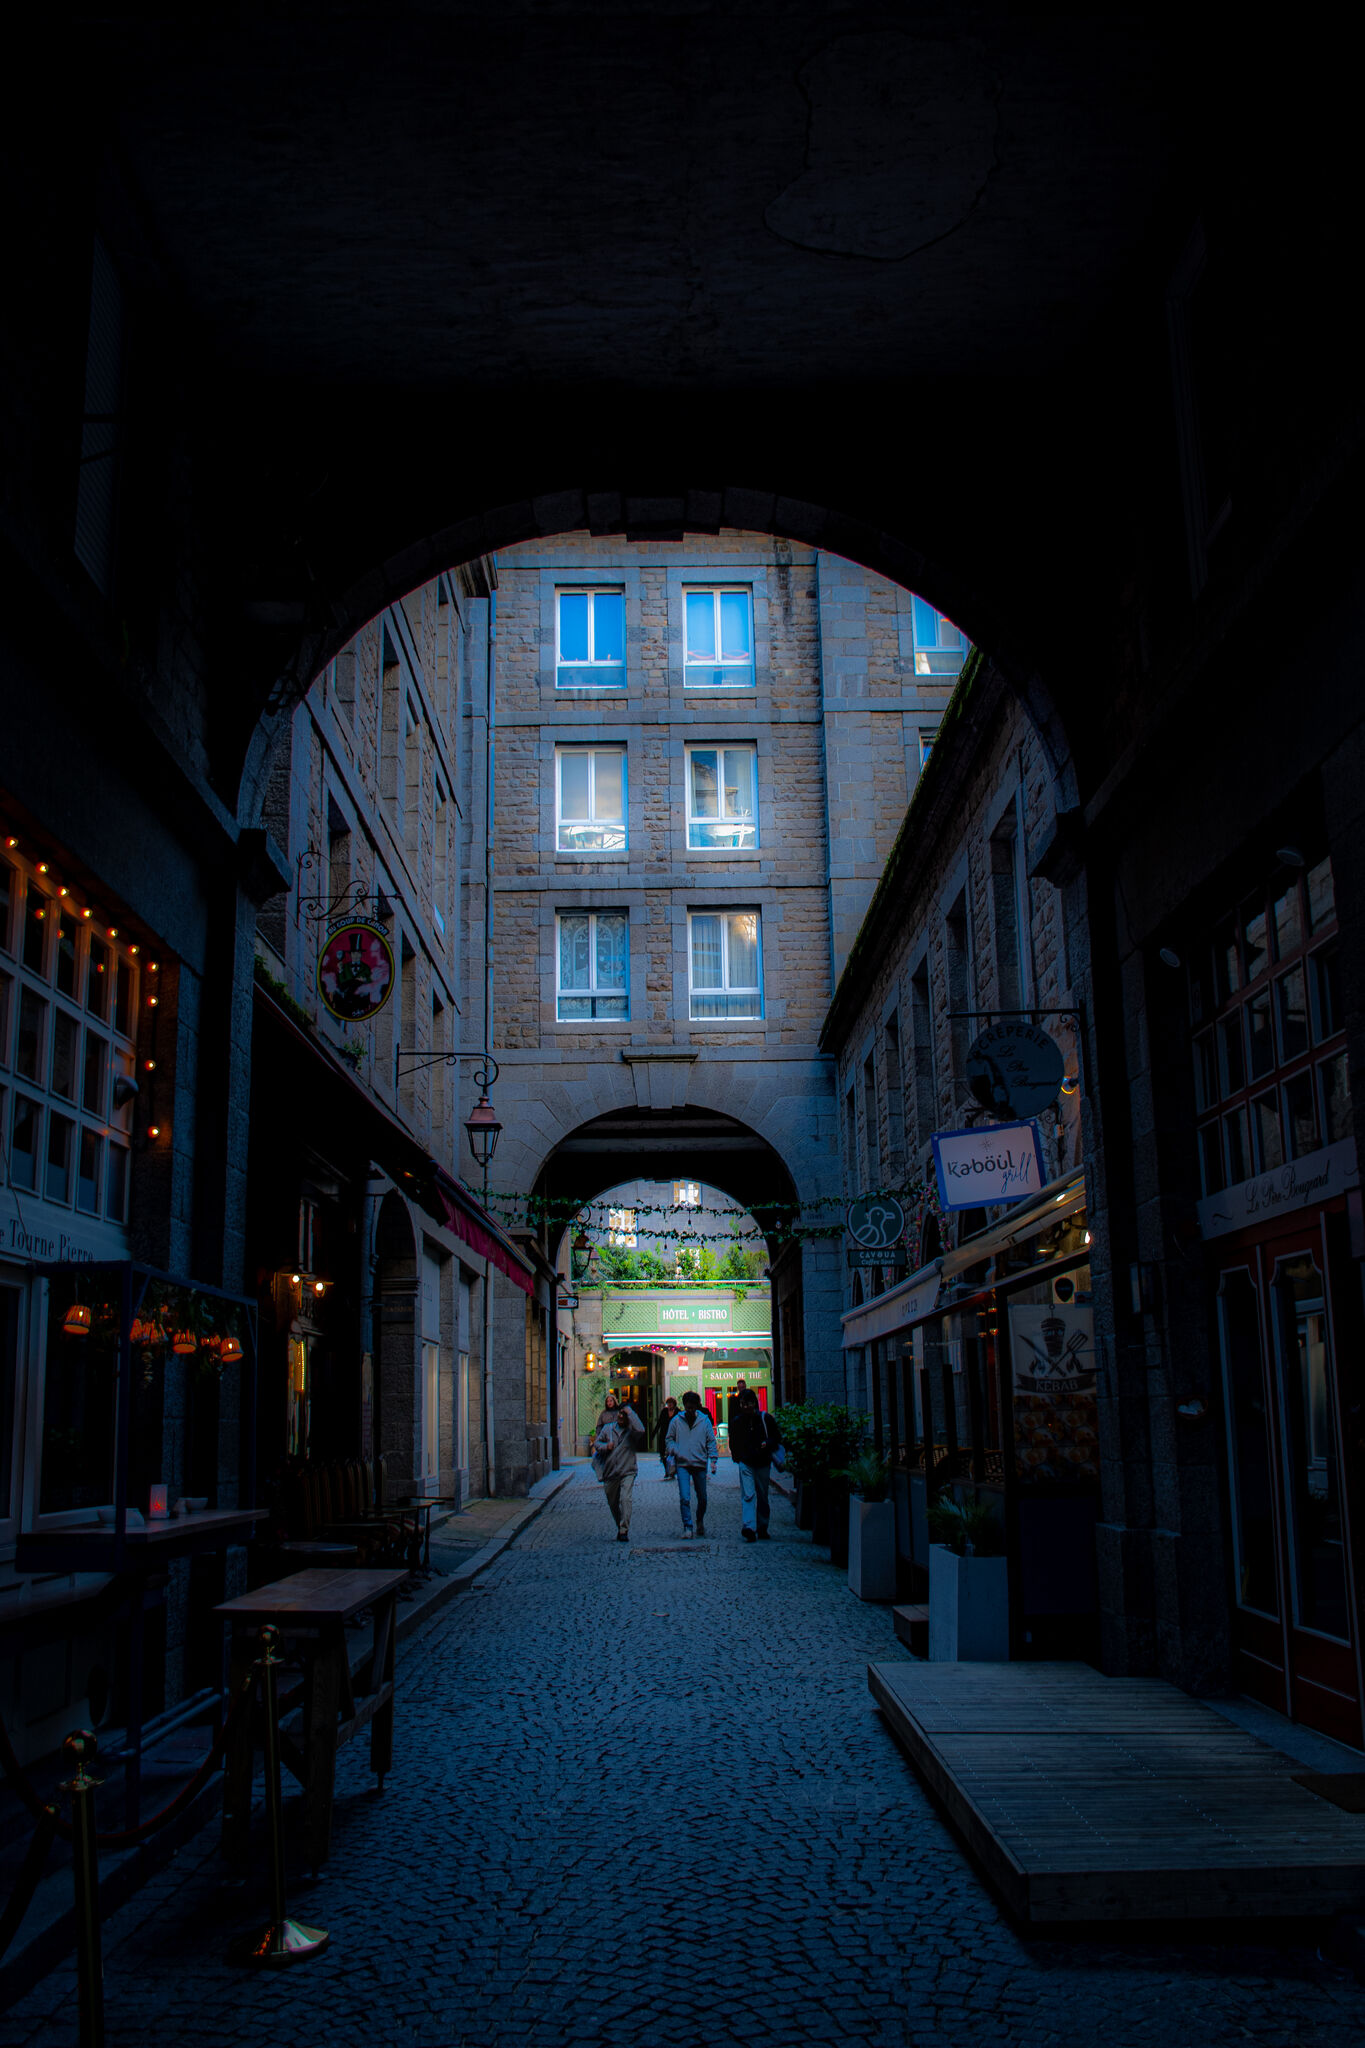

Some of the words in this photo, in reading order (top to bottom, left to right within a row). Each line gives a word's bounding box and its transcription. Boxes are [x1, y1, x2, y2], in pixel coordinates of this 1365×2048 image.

[336, 917, 355, 928] COUP
[1001, 1152, 1032, 1193] grill
[10, 1219, 55, 1257] Tourne
[58, 1234, 95, 1263] Pierre
[662, 1308, 689, 1320] HÔTEL
[698, 1309, 728, 1320] BISTRO
[710, 1372, 734, 1380] SALON
[748, 1370, 762, 1379] THÉ
[1035, 1379, 1079, 1393] KEBAB
